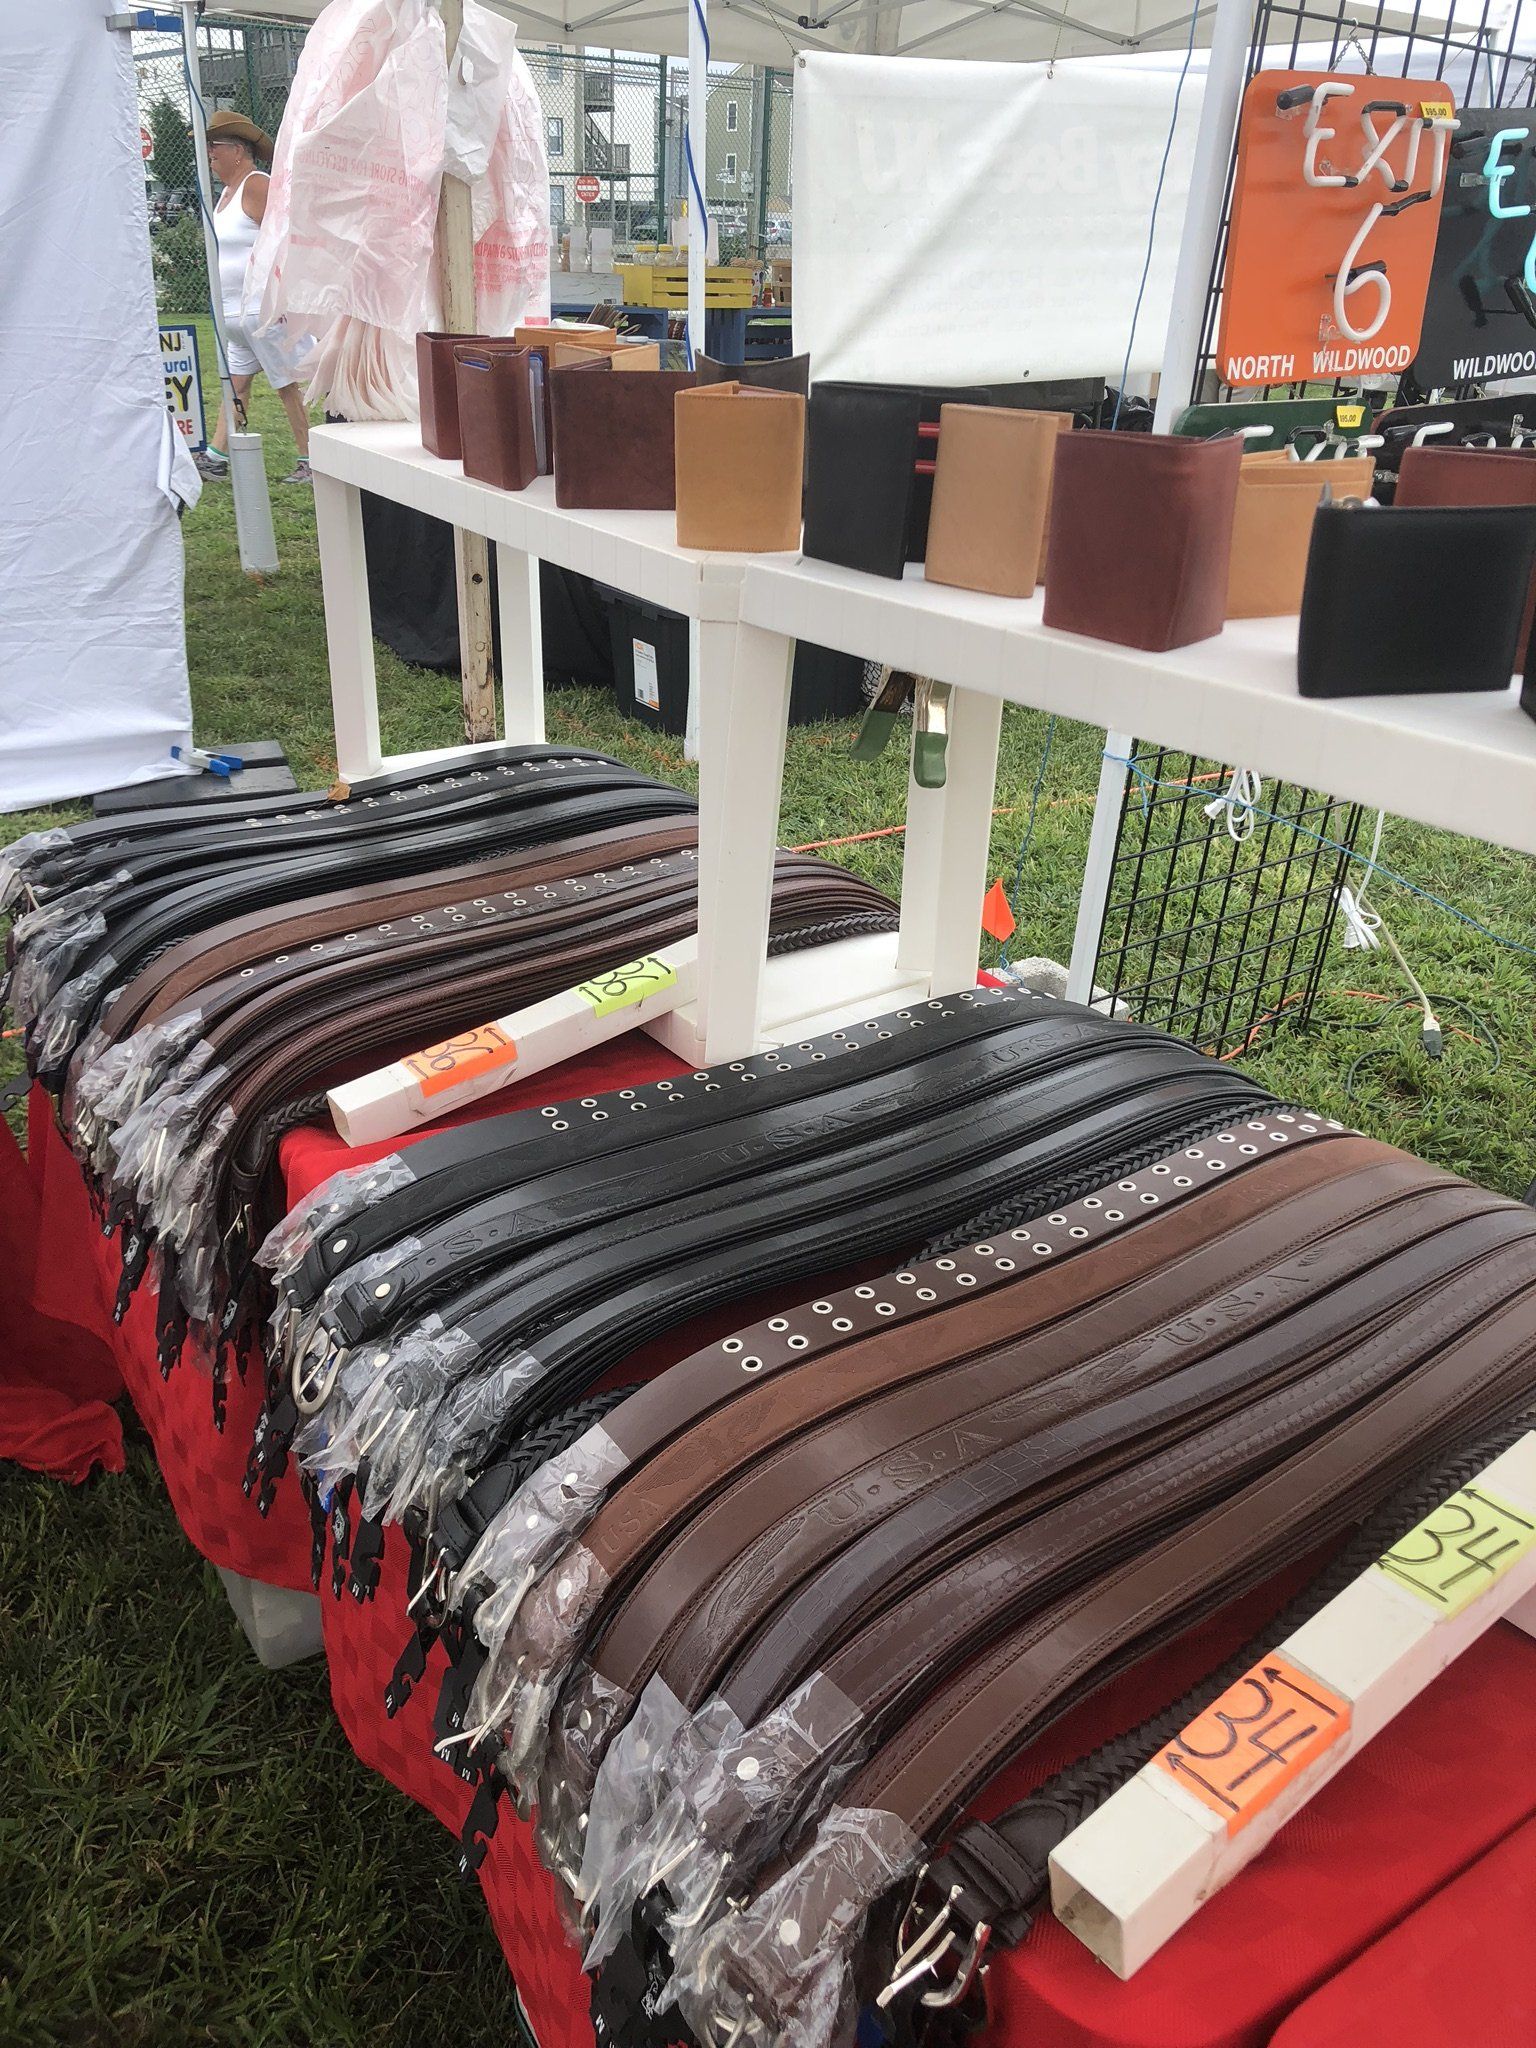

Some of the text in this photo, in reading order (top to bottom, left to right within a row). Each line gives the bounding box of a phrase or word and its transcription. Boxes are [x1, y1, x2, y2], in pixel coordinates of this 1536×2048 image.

[1304, 81, 1461, 197] EXIT
[1334, 203, 1391, 341] 6
[159, 332, 181, 351] NJ
[1227, 345, 1411, 380] NORTH WILDWOOD
[1453, 350, 1536, 380] WILDWOO
[590, 960, 659, 996] 36
[420, 1032, 493, 1071] 36
[1385, 1504, 1520, 1590] 34
[1177, 1678, 1317, 1790] 34
